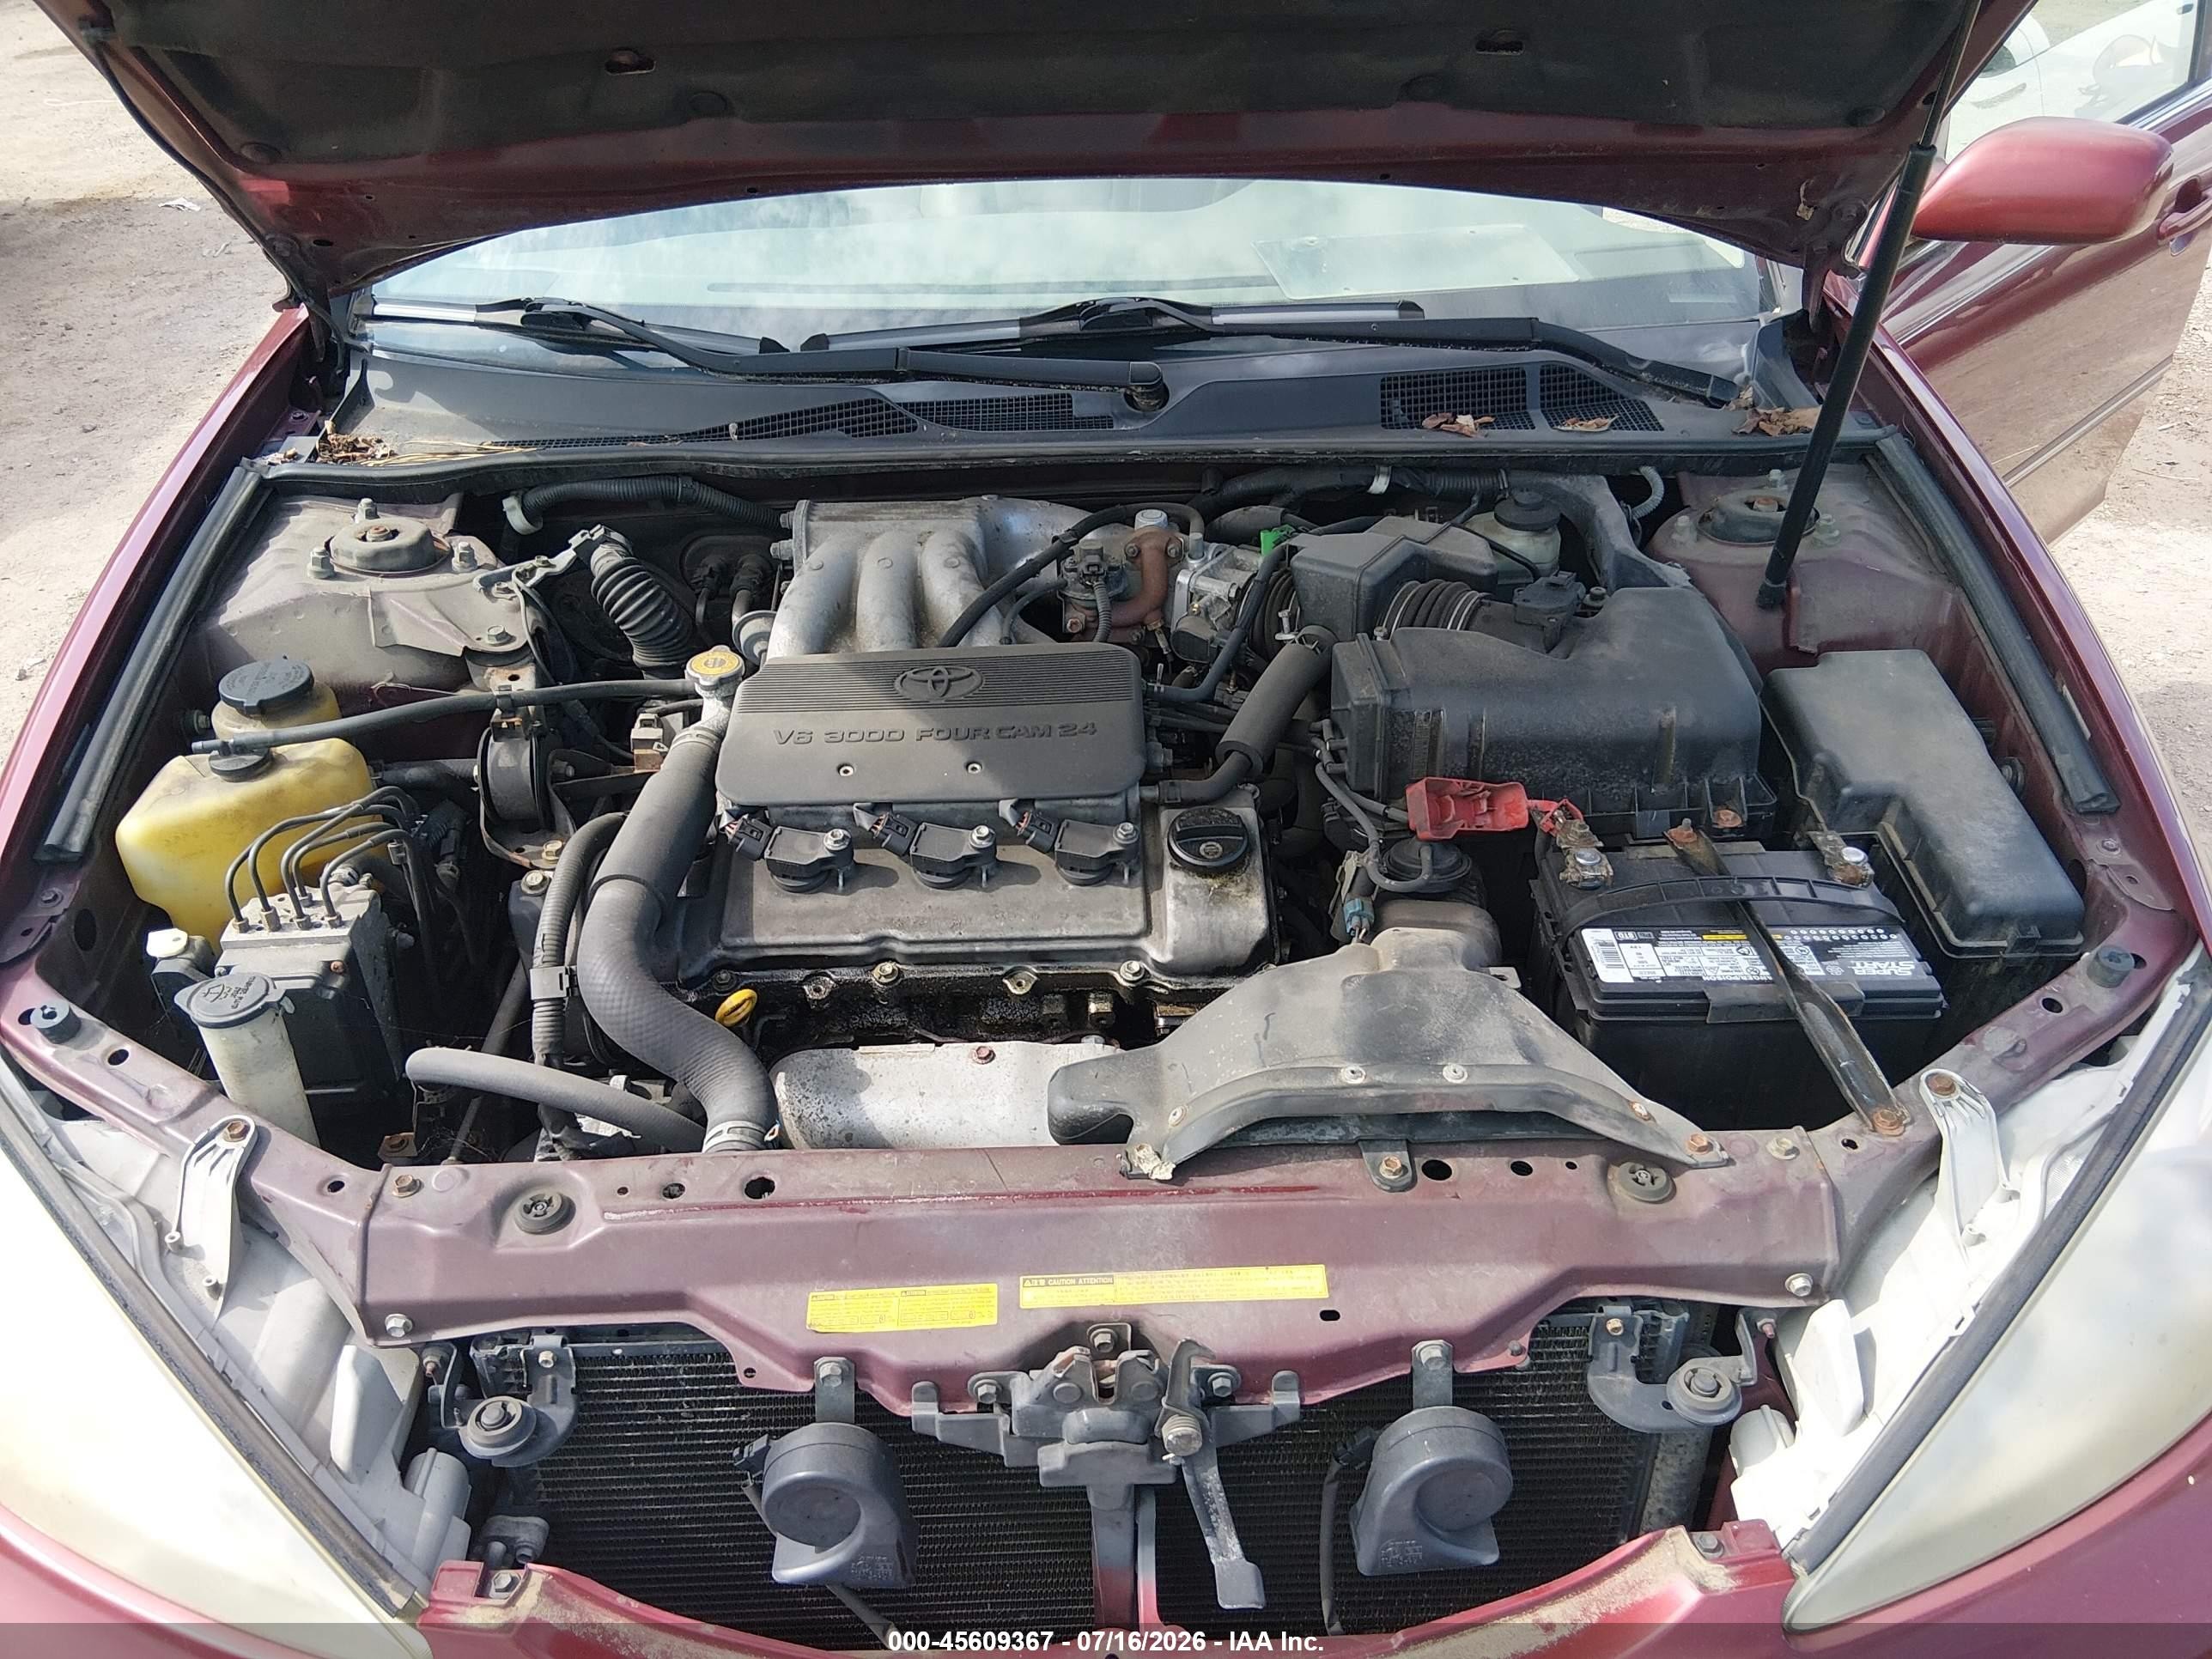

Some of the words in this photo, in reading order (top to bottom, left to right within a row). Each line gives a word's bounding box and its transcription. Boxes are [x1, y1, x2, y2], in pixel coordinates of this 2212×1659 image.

[773, 729, 814, 745] V6
[823, 728, 905, 744] 3000
[915, 726, 990, 742] FOUR
[994, 725, 1054, 740] CAM
[1057, 722, 1098, 738] 24
[1048, 1277, 1076, 1286] CAUTION
[1078, 1275, 1114, 1285] ATTENTION
